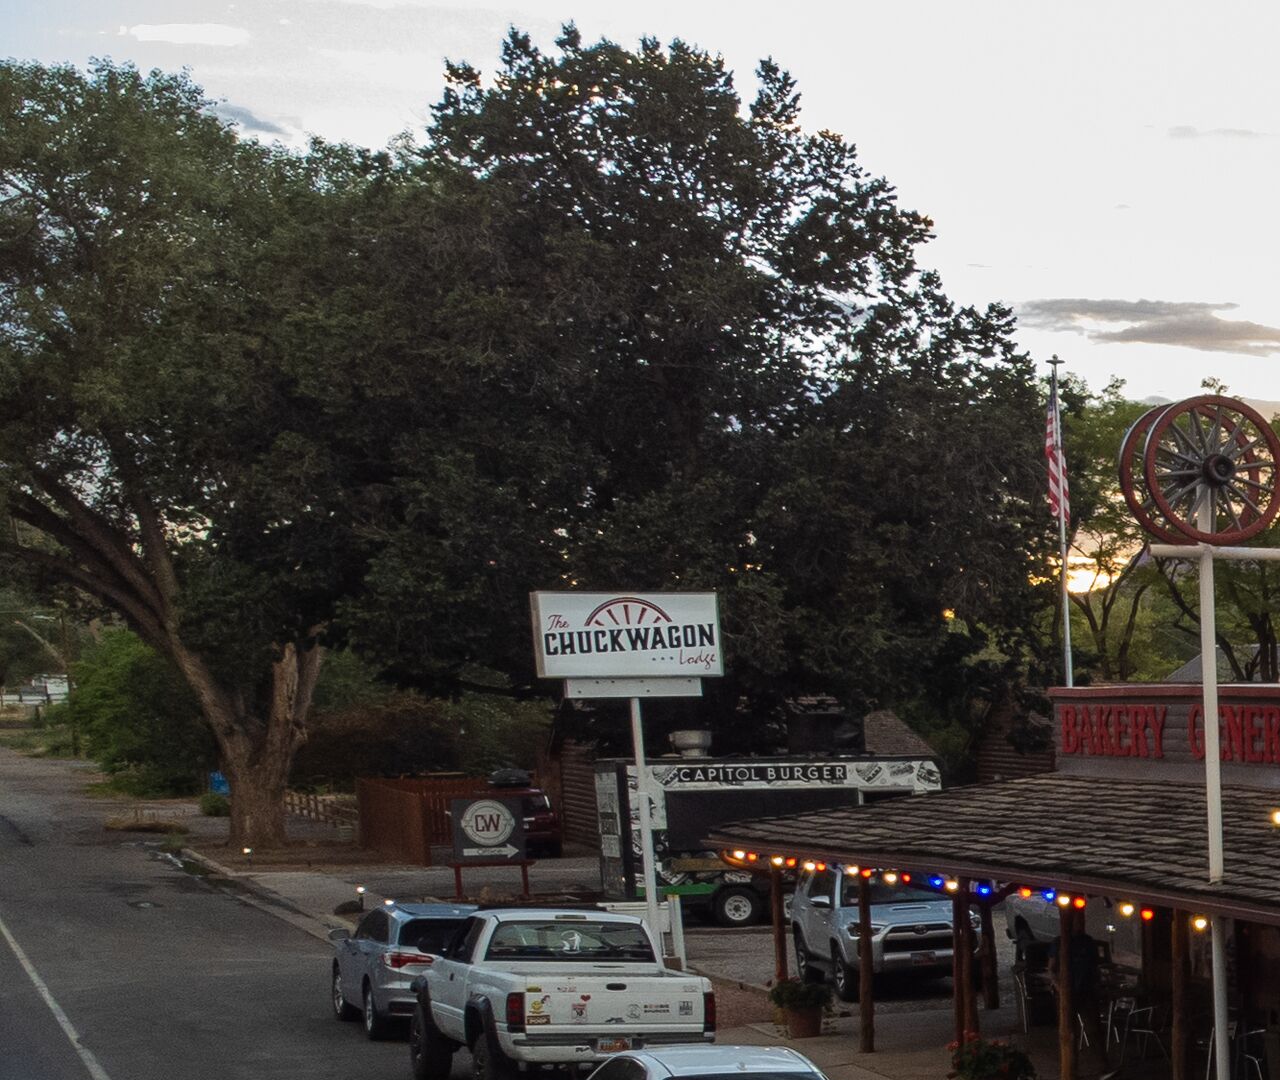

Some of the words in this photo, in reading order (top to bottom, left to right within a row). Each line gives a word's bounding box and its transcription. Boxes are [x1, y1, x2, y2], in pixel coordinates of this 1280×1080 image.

[548, 614, 569, 631] The
[544, 623, 716, 656] CHUCKWAGON
[679, 650, 716, 670] Lodge
[1060, 703, 1166, 759] BAKERY
[680, 768, 760, 781] CAPITOL
[767, 767, 844, 782] BURGER
[475, 814, 501, 832] CW
